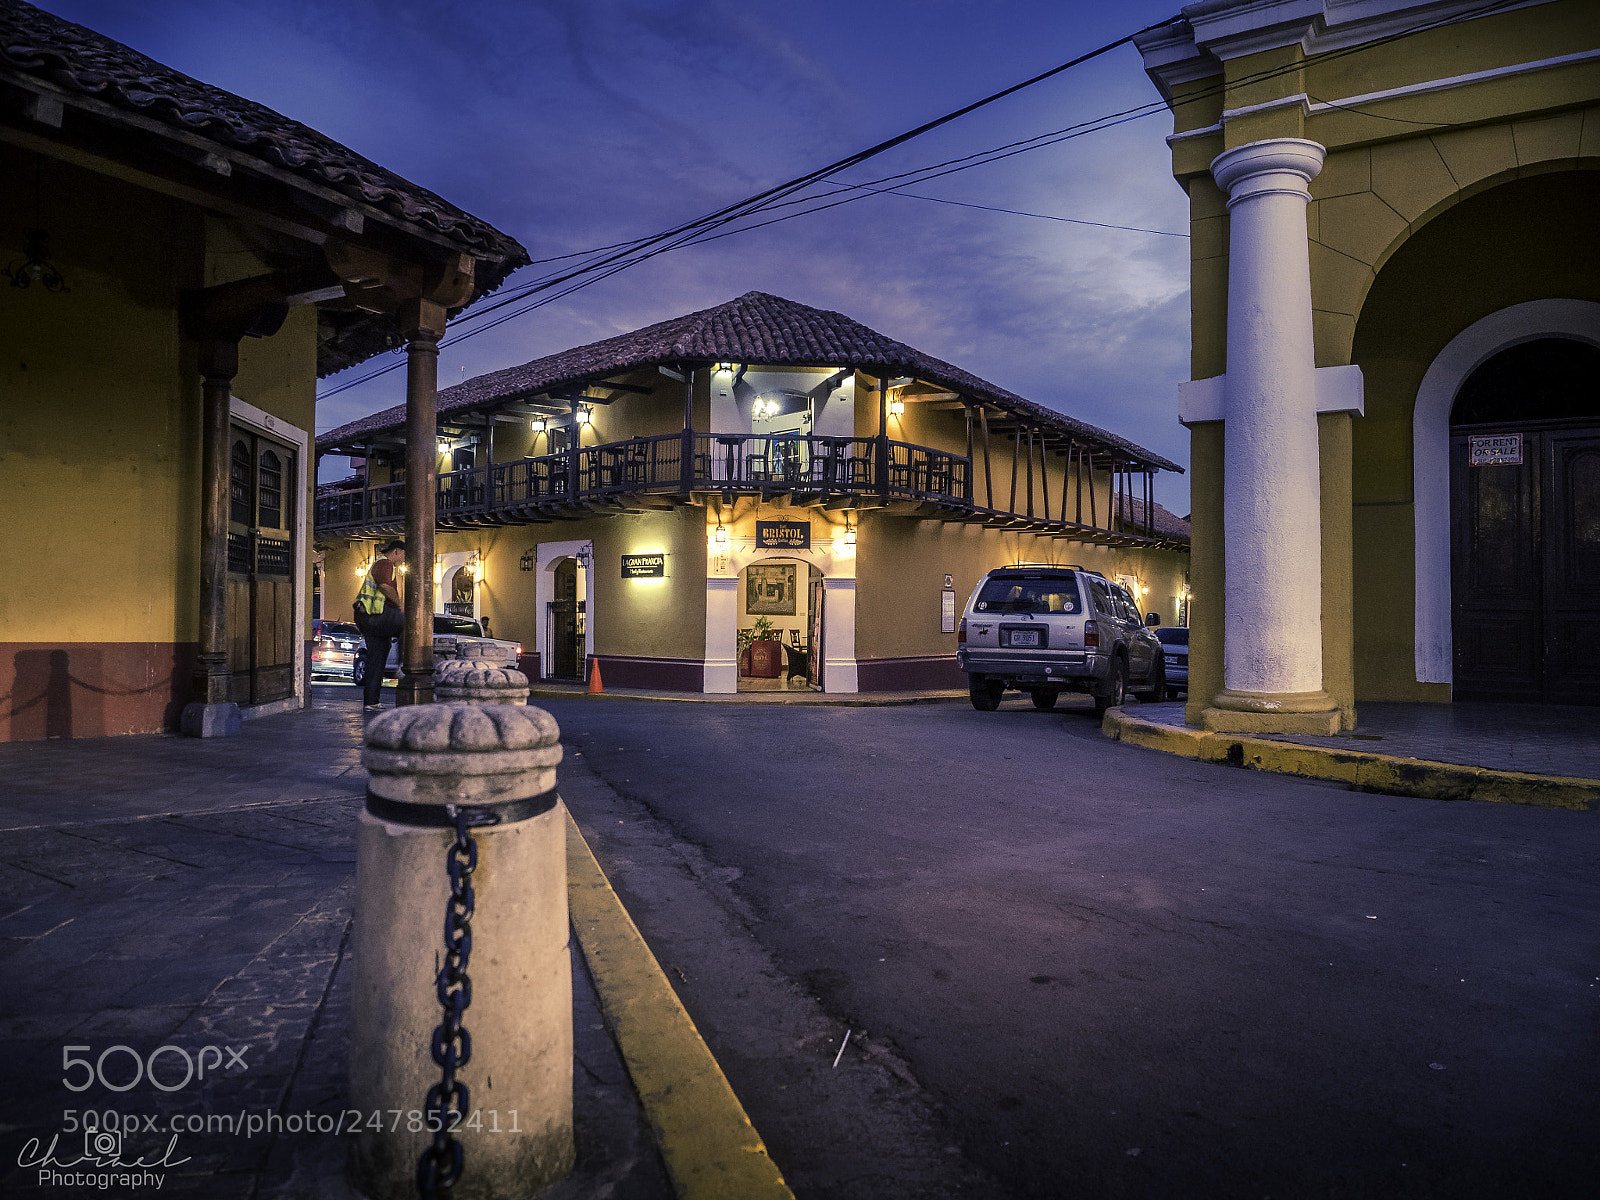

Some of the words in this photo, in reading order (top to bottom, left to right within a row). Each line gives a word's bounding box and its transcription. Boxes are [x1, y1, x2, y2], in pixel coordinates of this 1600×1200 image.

[1493, 437, 1518, 447] RENT
[1490, 446, 1516, 456] SALE
[762, 528, 804, 539] BRISTOL
